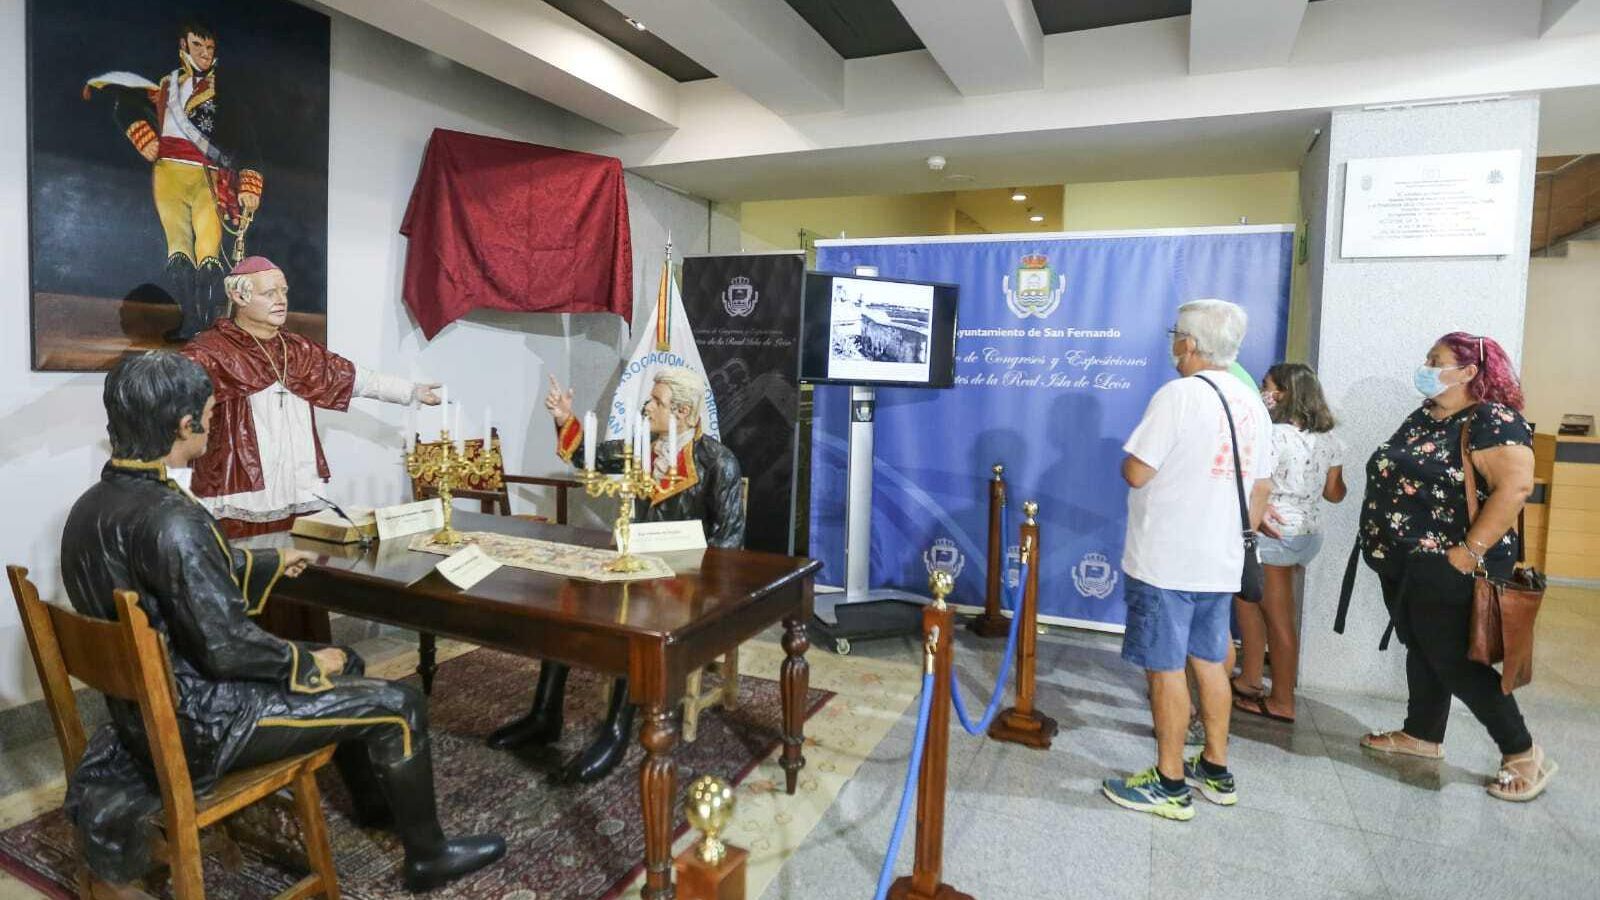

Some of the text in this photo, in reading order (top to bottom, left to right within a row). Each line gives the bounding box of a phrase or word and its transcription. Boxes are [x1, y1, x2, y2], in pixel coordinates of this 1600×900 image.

[1028, 328, 1041, 337] de
[1043, 328, 1064, 337] San
[1067, 328, 1121, 337] Fernando
[621, 352, 685, 382] SOCIACION
[963, 347, 1148, 370] de Congresos y Exposiciones
[971, 373, 985, 385] de
[987, 374, 998, 385] la
[1002, 371, 1041, 387] Real
[1041, 372, 1071, 387] Isla
[1074, 376, 1089, 387] de
[1093, 372, 1130, 389] León
